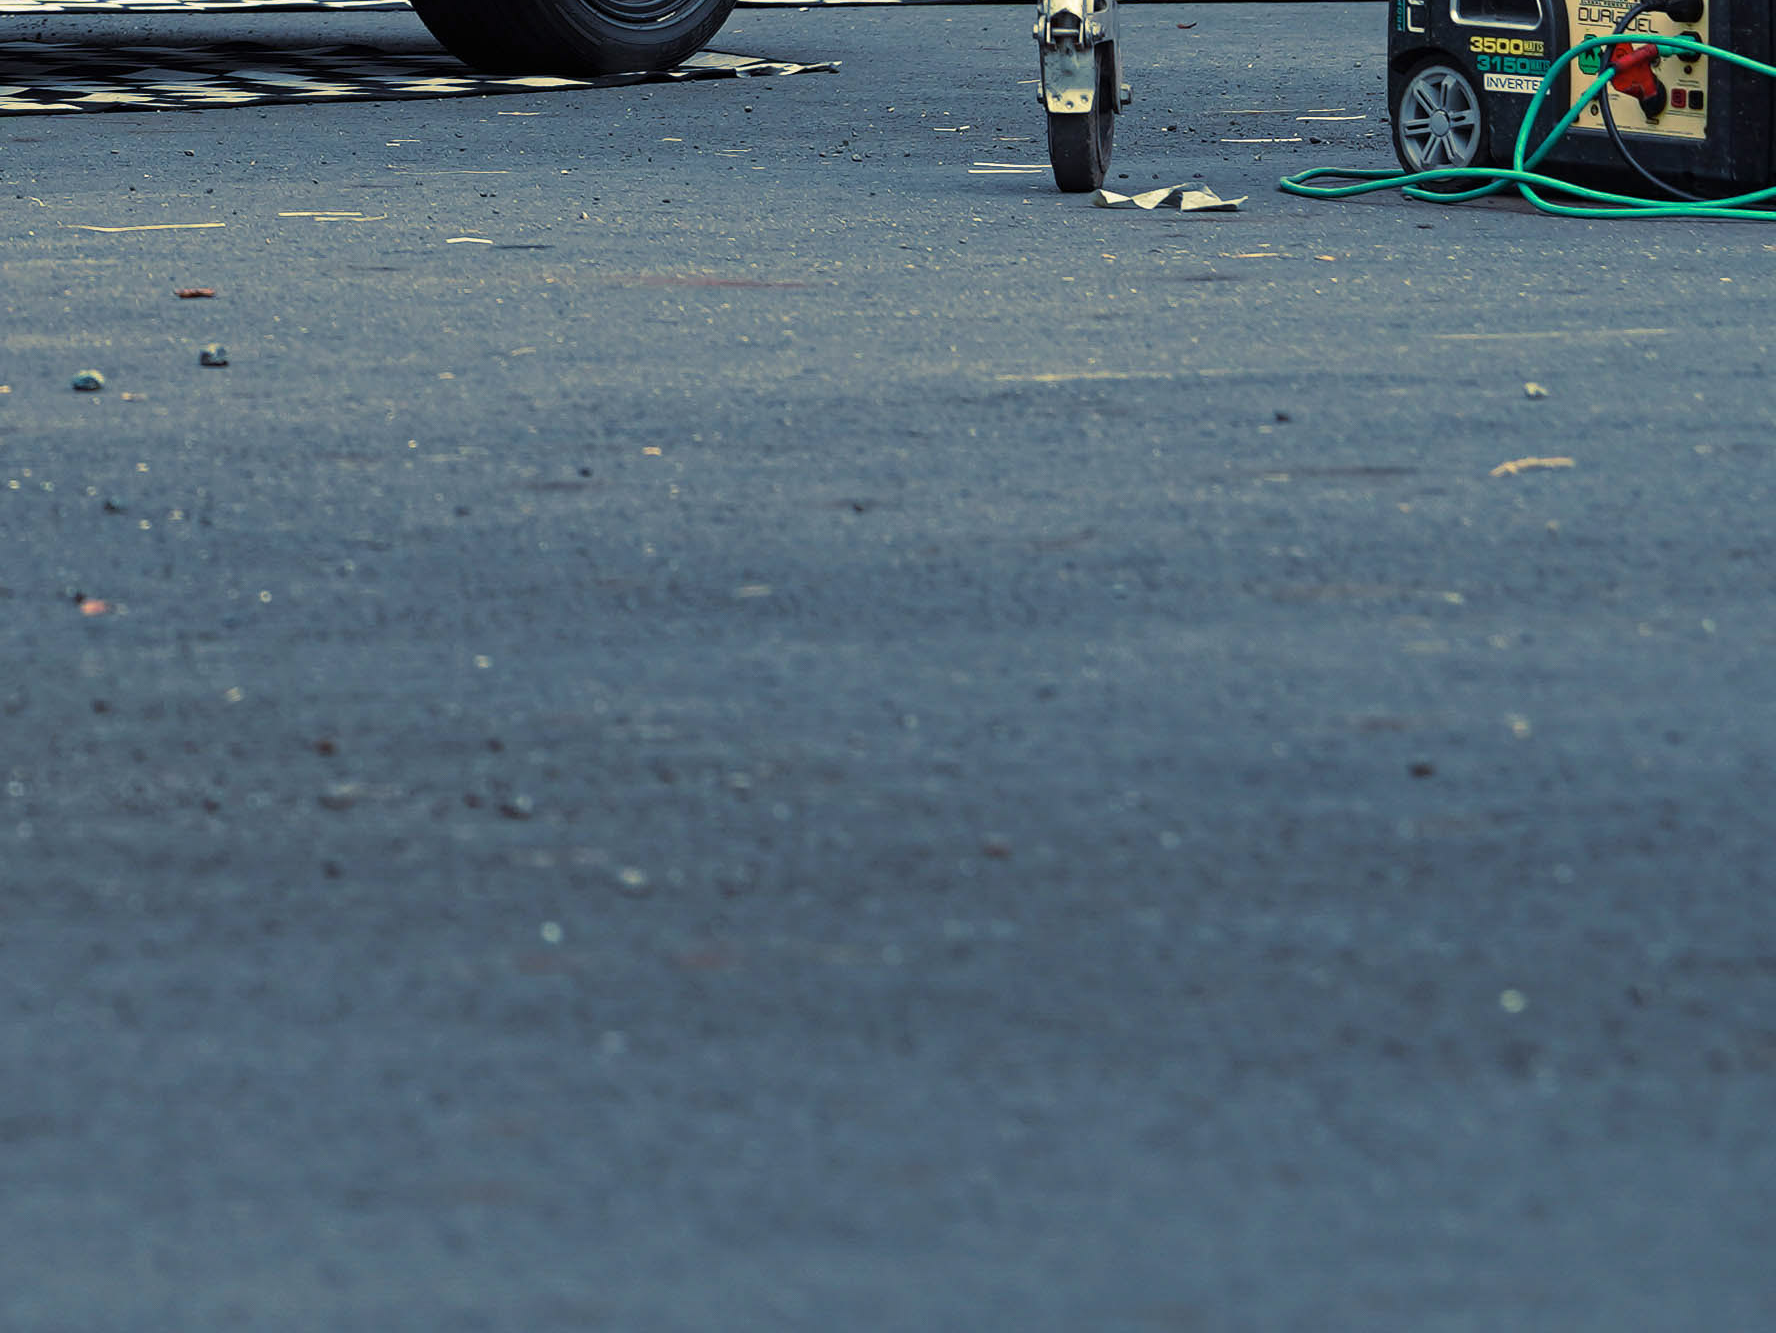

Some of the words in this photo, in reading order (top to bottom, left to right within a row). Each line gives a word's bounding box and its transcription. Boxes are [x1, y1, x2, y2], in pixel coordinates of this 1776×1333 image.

[1470, 36, 1523, 55] 3500
[1476, 54, 1530, 73] 3150
[1487, 76, 1541, 91] INVERTE
